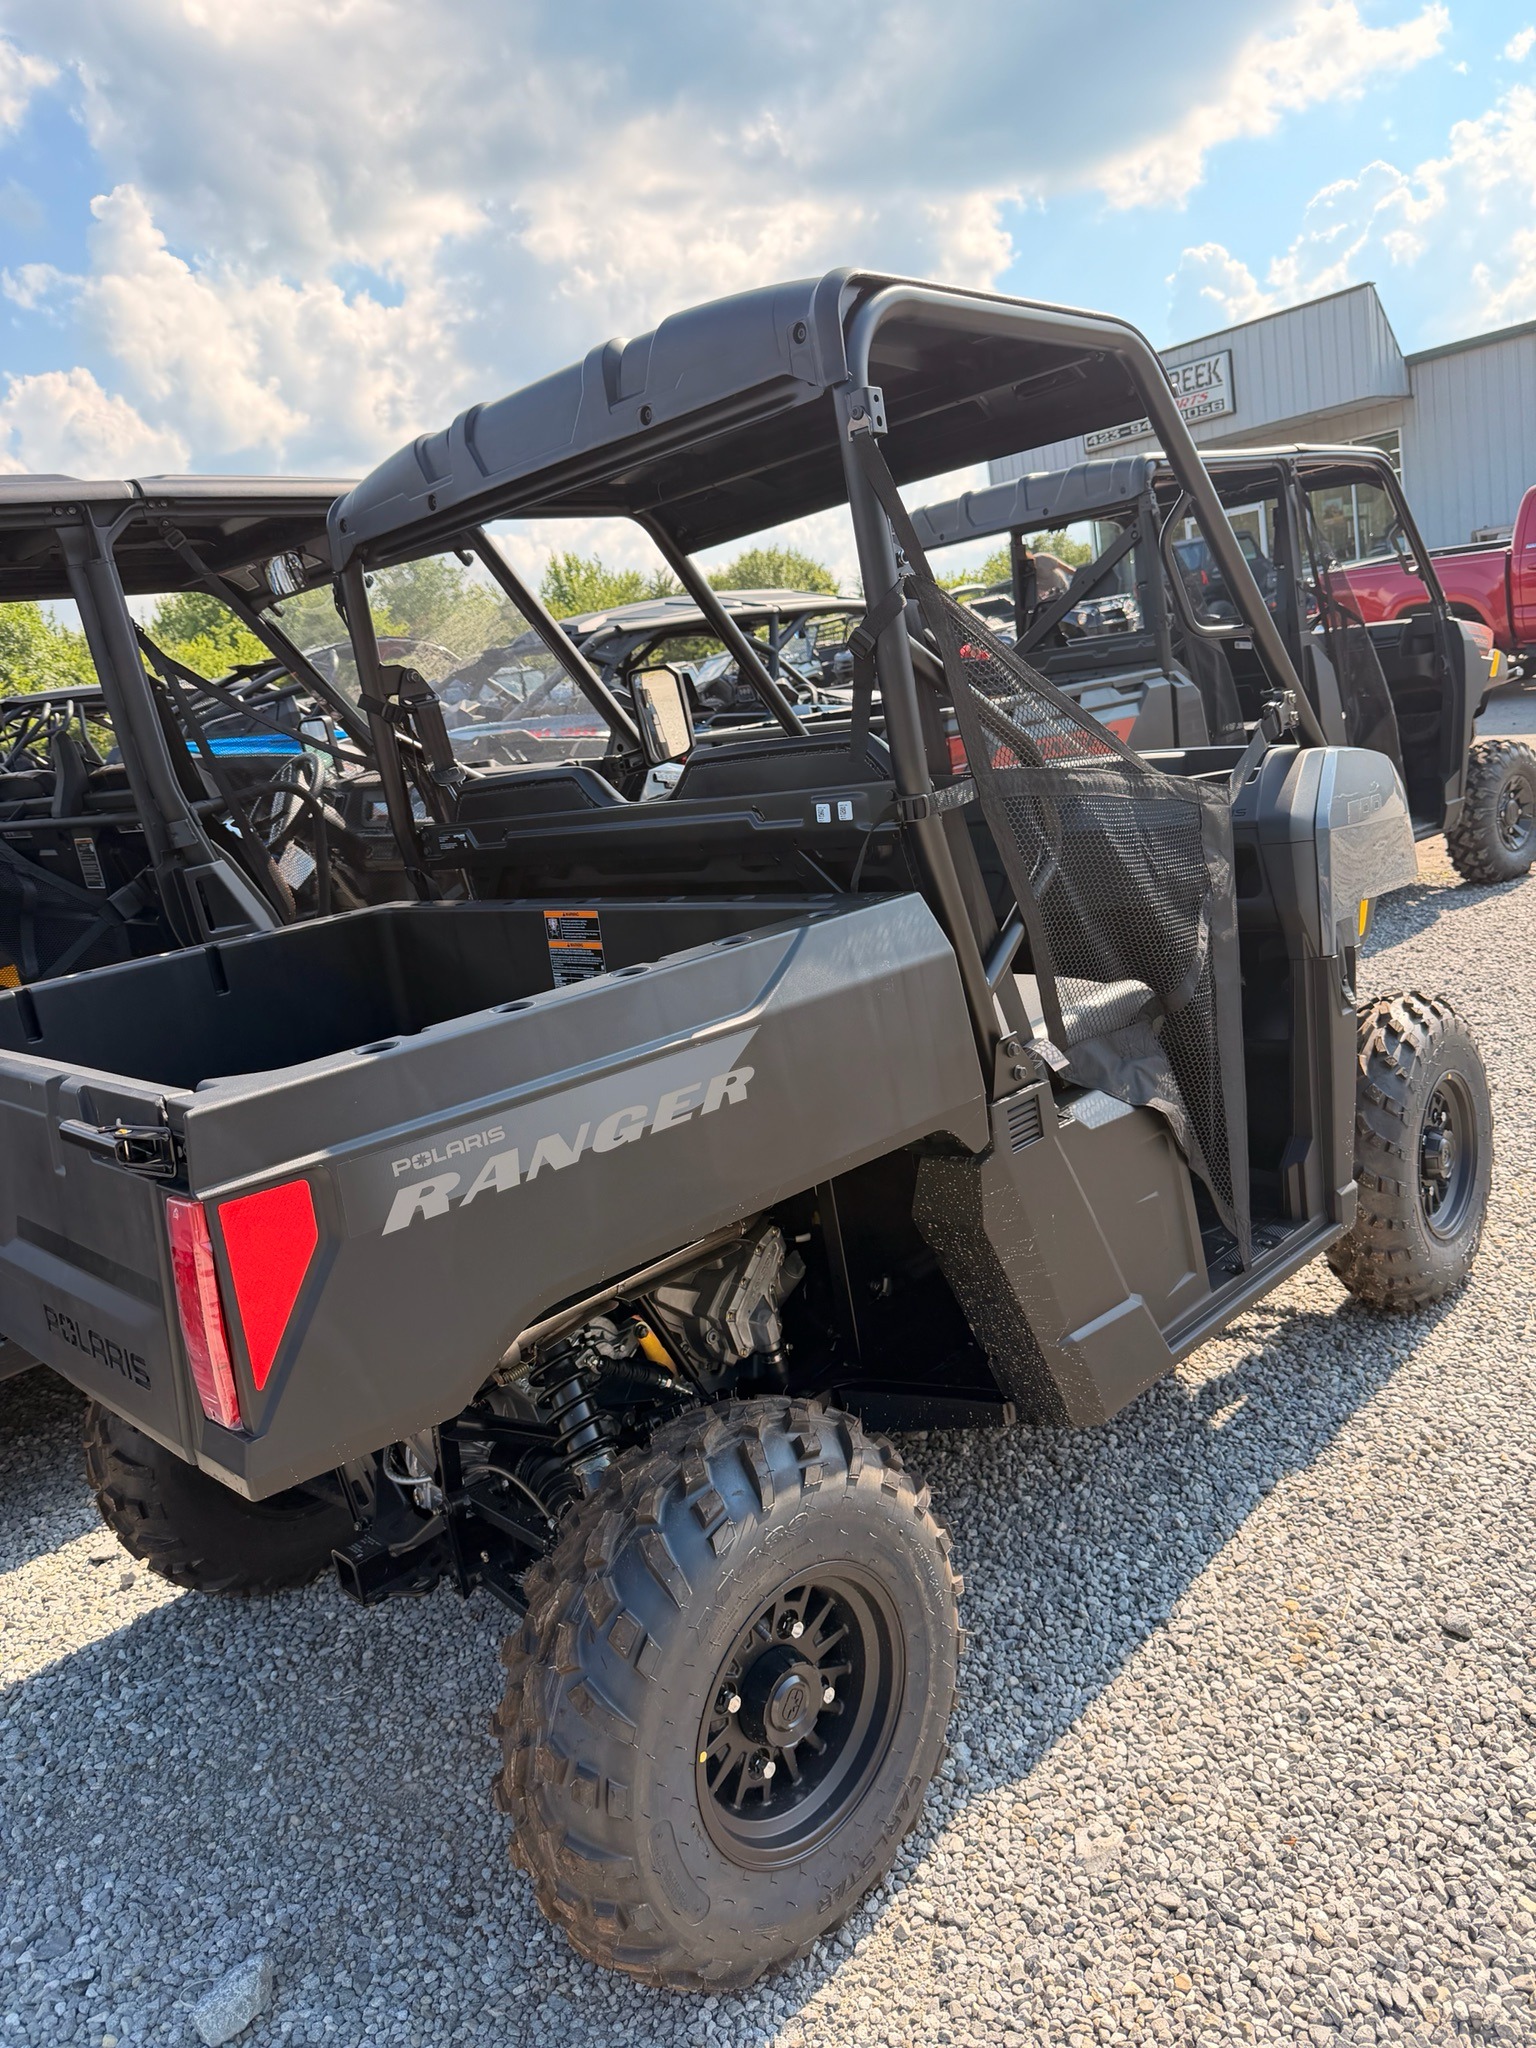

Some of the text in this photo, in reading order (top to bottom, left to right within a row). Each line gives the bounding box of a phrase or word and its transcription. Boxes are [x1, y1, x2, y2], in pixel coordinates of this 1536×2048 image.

[381, 1066, 755, 1236] RANGER
[391, 1125, 506, 1178] POLARIS
[43, 1303, 152, 1391] POLARIS
